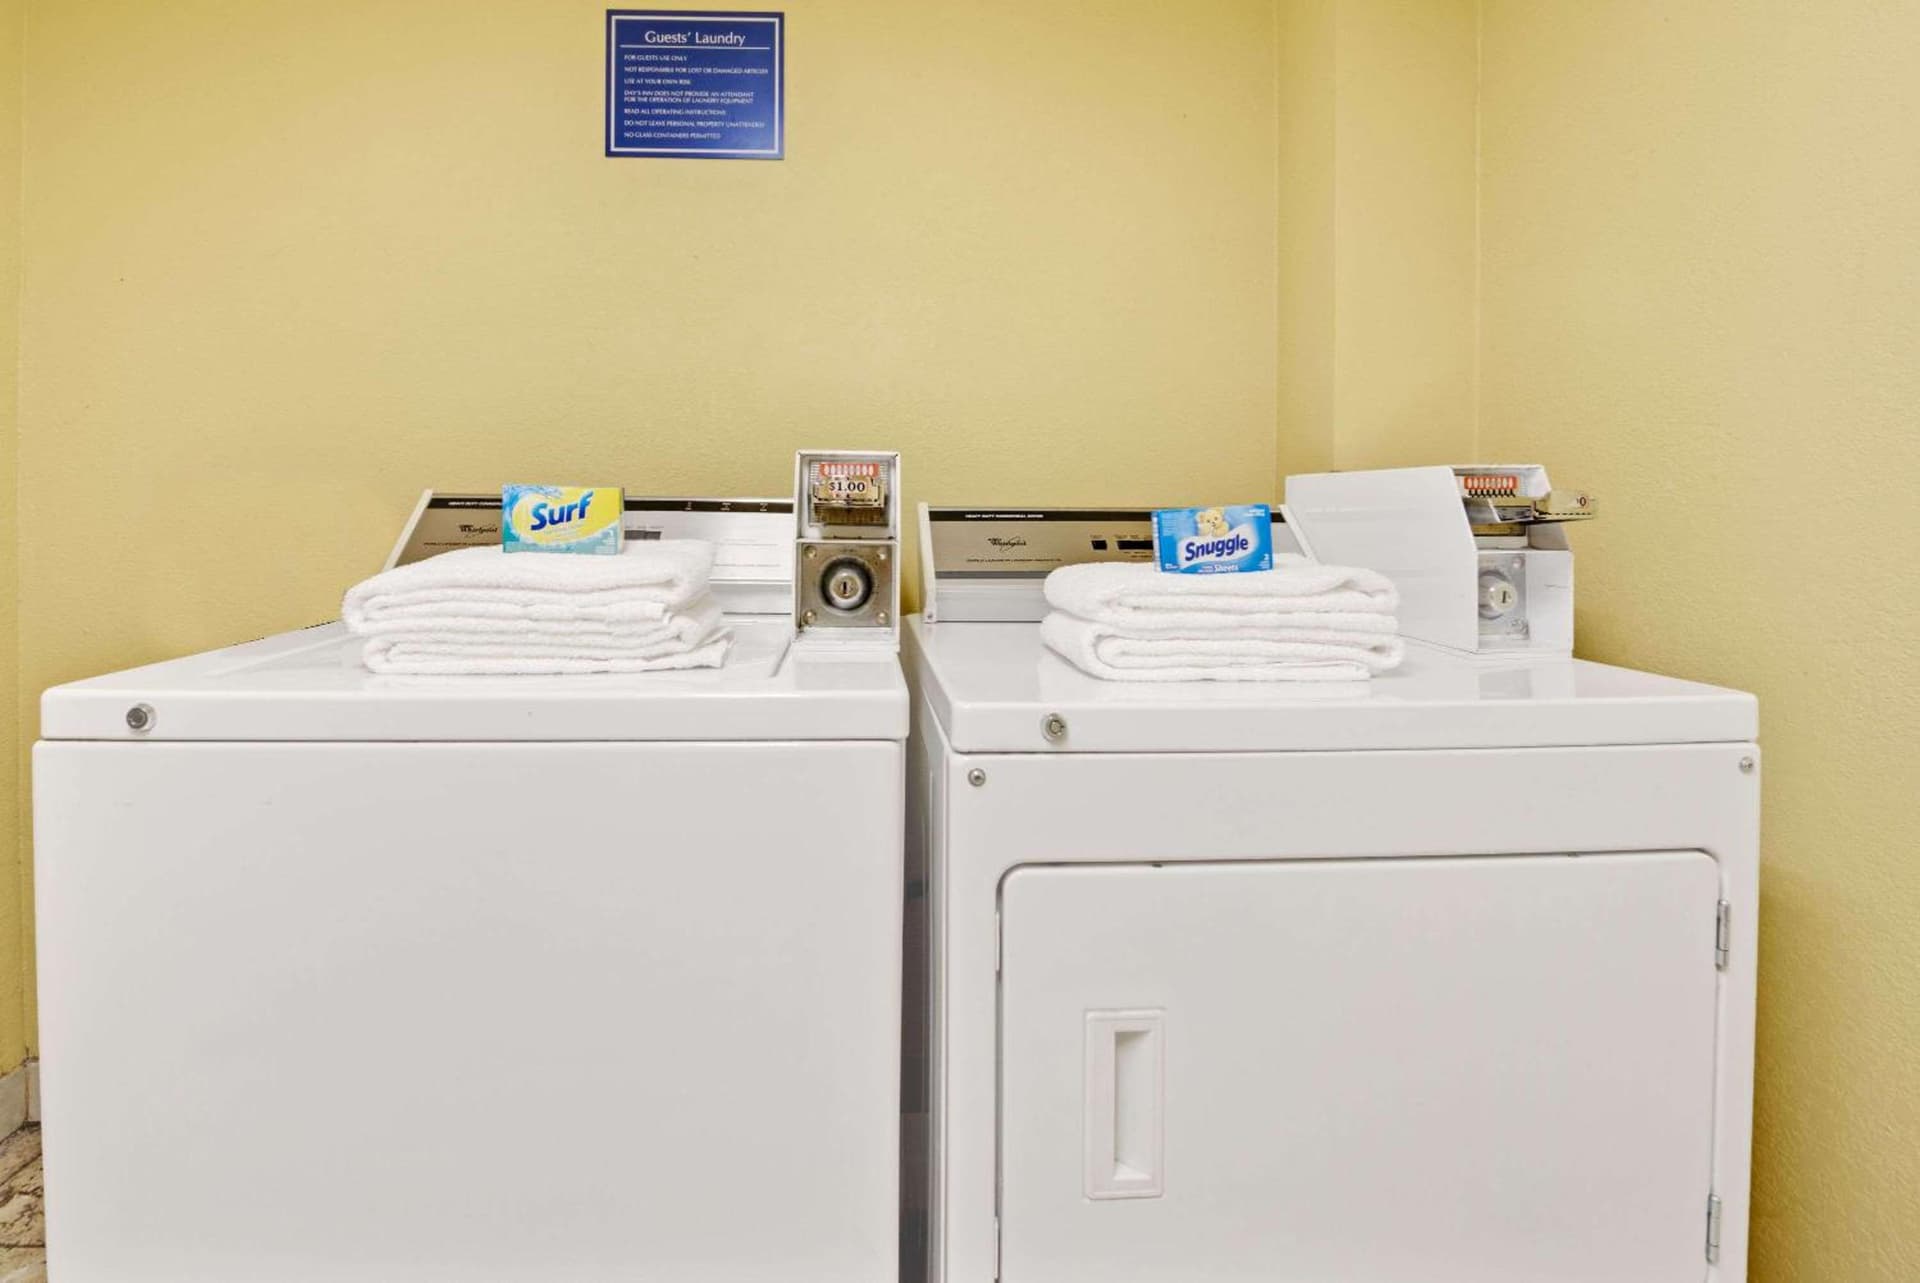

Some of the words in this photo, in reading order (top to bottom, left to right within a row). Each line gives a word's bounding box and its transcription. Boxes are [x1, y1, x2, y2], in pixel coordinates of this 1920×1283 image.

[644, 30, 691, 43] Guests'
[695, 31, 746, 47] Laundry
[828, 481, 866, 493] $1.00
[530, 490, 593, 531] Surf
[1184, 534, 1249, 562] Snuggle
